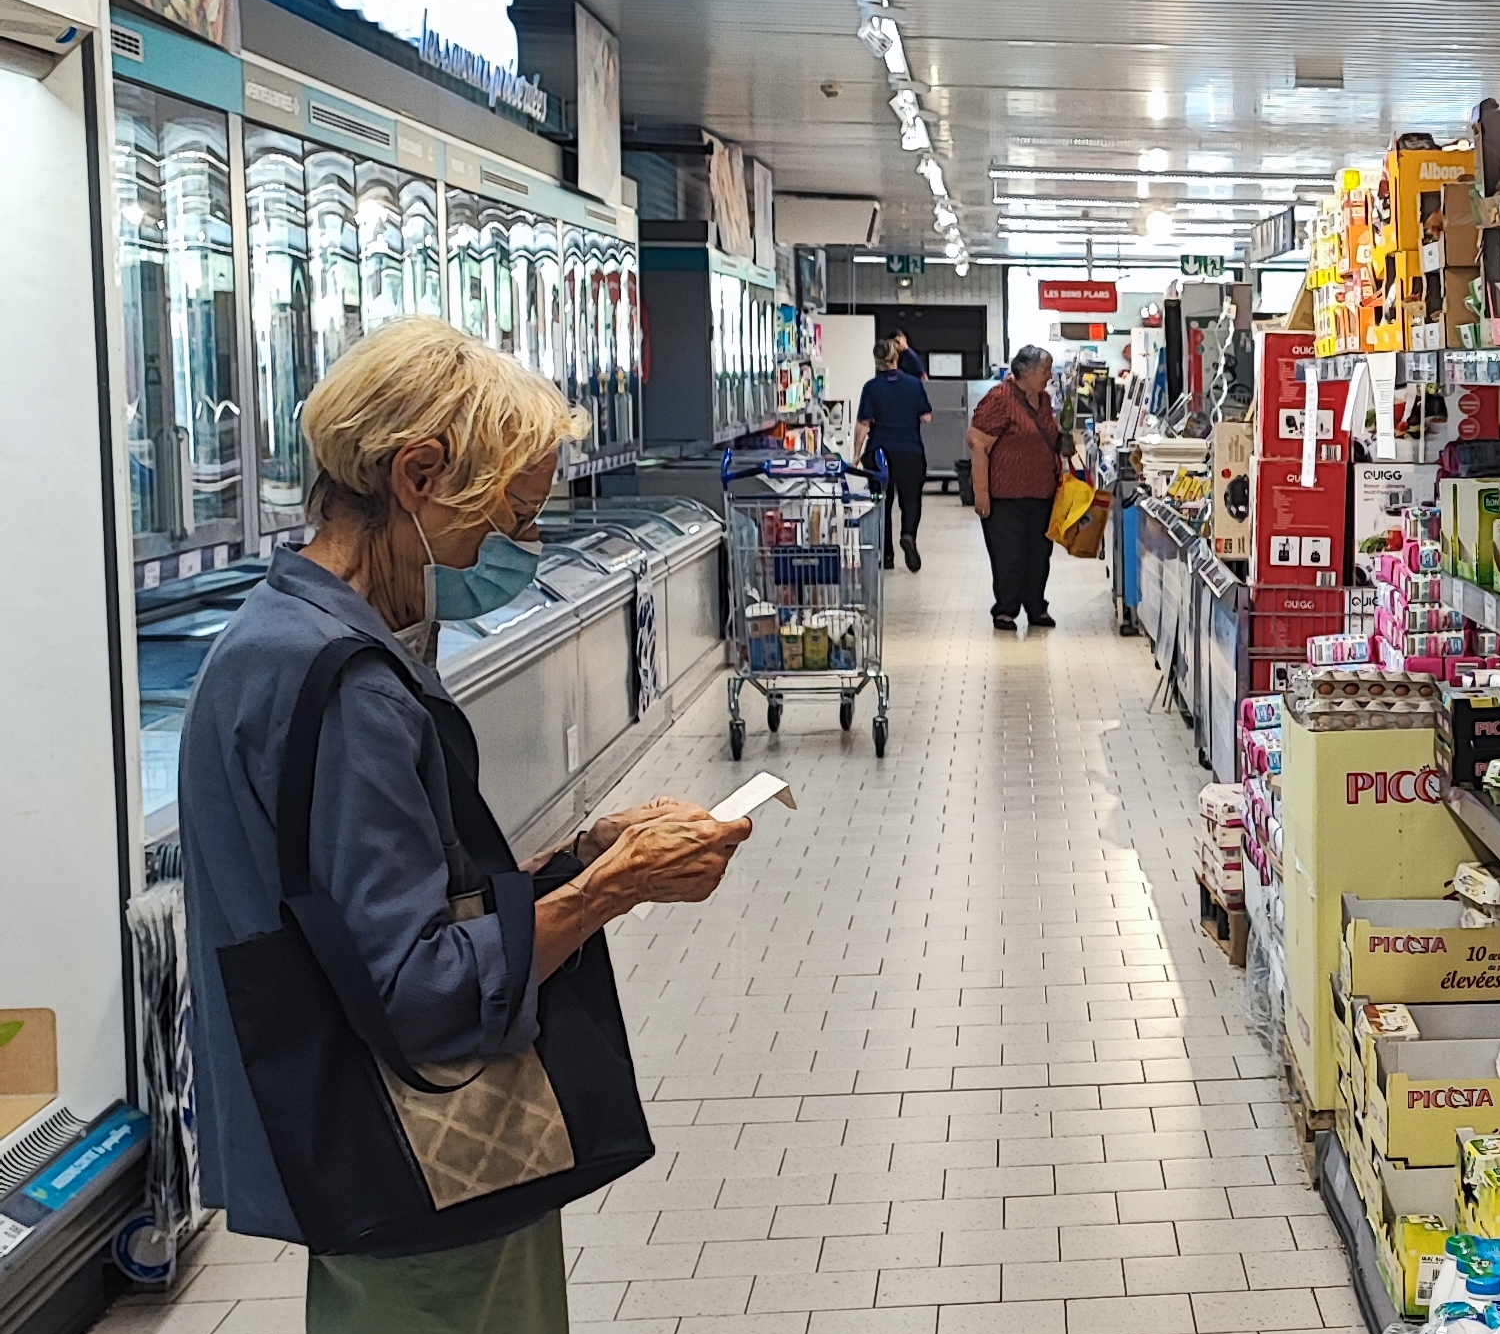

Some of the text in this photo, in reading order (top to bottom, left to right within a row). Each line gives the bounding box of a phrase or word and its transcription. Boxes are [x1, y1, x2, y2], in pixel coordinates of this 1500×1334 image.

[1420, 162, 1465, 180] Albona
[1364, 470, 1403, 481] QUIGG
[1370, 936, 1448, 953] PICOTA
[1467, 947, 1486, 962] 10
[1408, 1088, 1494, 1109] PICOTA
